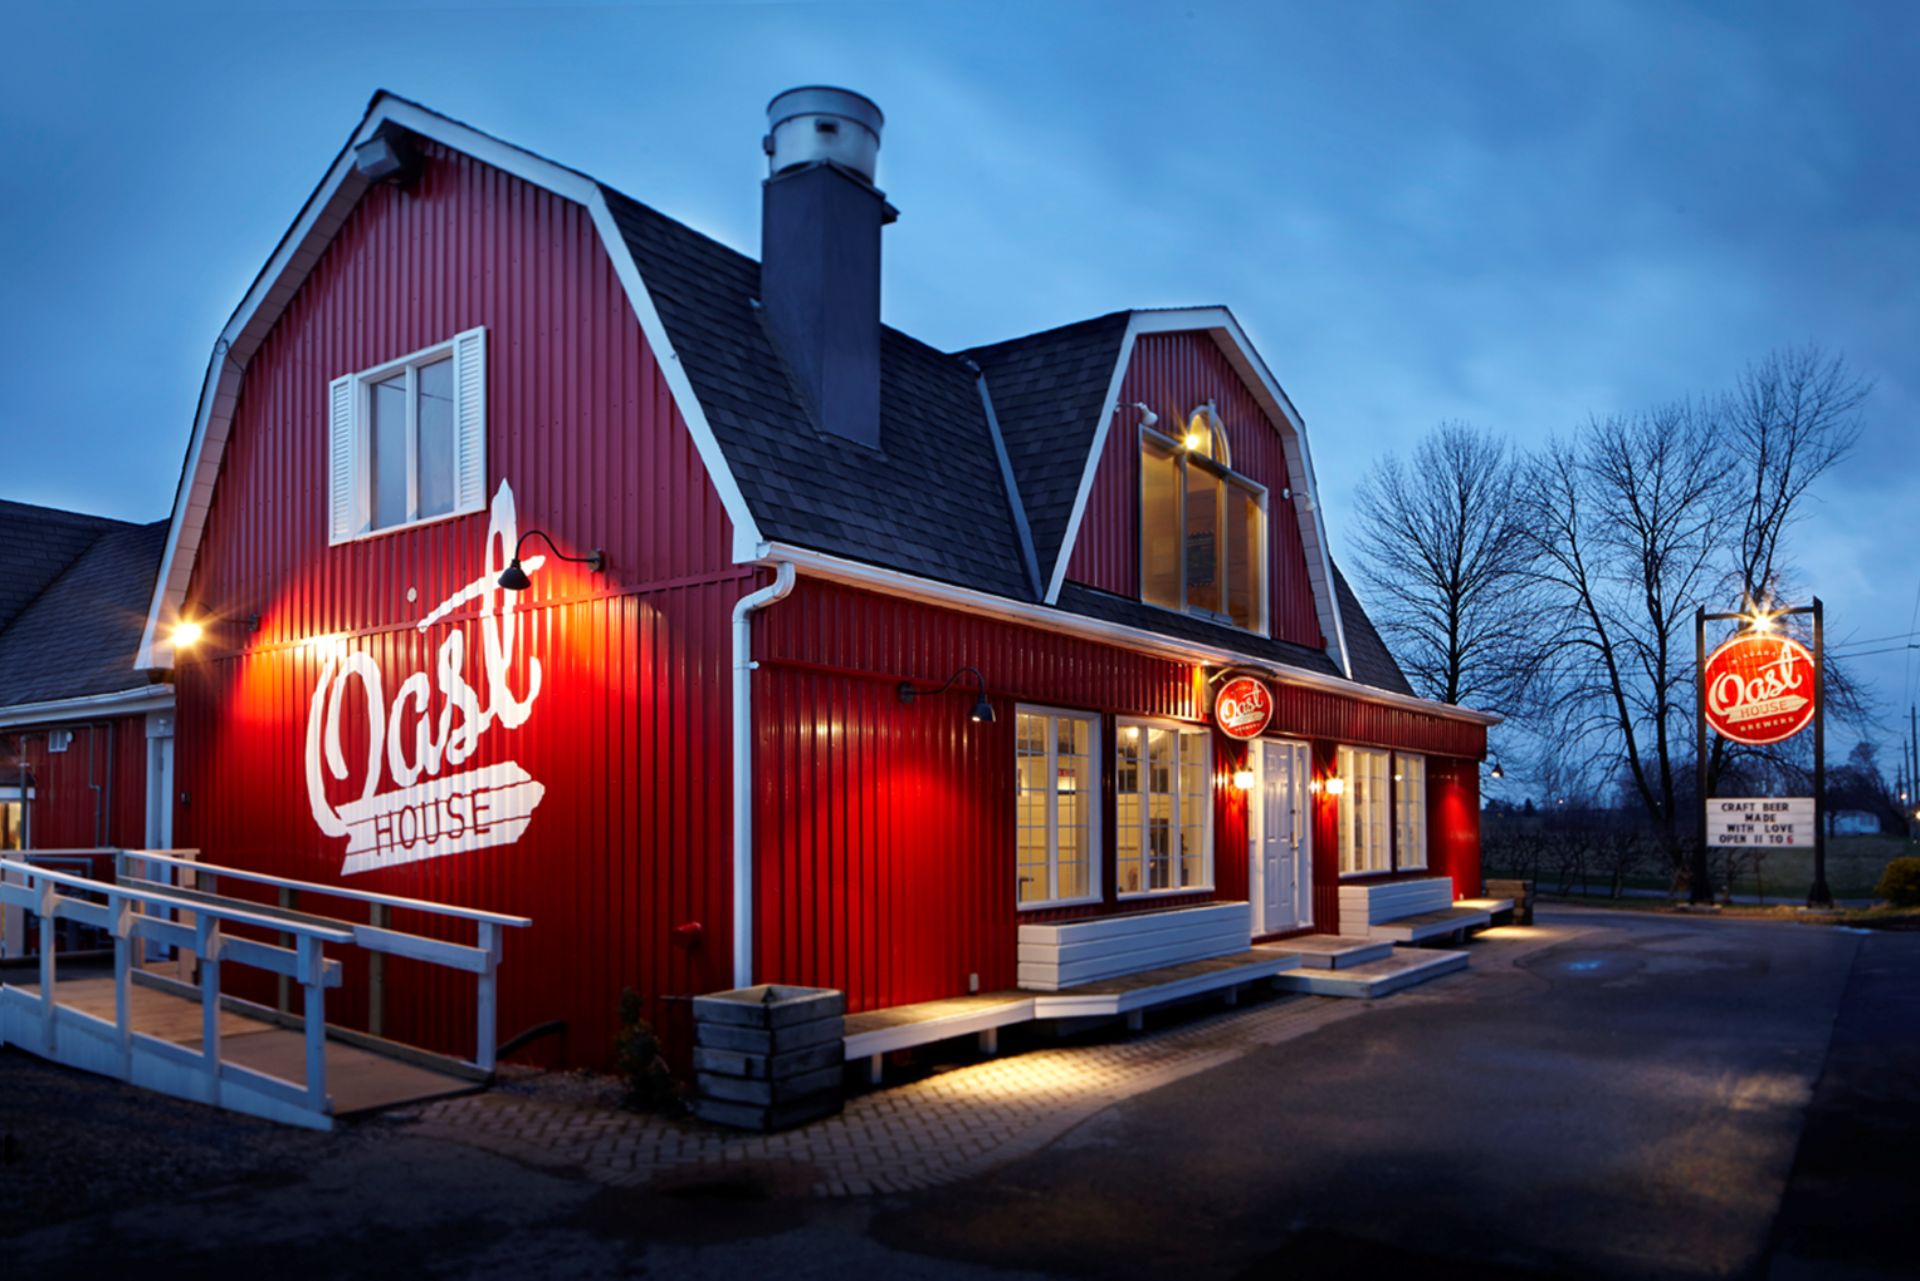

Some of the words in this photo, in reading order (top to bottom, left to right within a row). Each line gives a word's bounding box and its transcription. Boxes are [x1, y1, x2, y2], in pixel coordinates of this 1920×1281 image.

[305, 478, 545, 837] Oast
[1709, 641, 1802, 716] Oast
[1741, 702, 1787, 718] HOUSE
[1740, 716, 1794, 731] BREWERS
[1721, 803, 1755, 812] CRAFT
[1763, 803, 1789, 812] BEER
[374, 786, 491, 856] HOUSE
[1745, 814, 1776, 822] MADE
[1727, 824, 1754, 833] WITH
[1765, 824, 1794, 833] LOVE
[1719, 835, 1746, 843] OPEN
[1769, 835, 1784, 844] TO
[1786, 835, 1794, 845] 6
